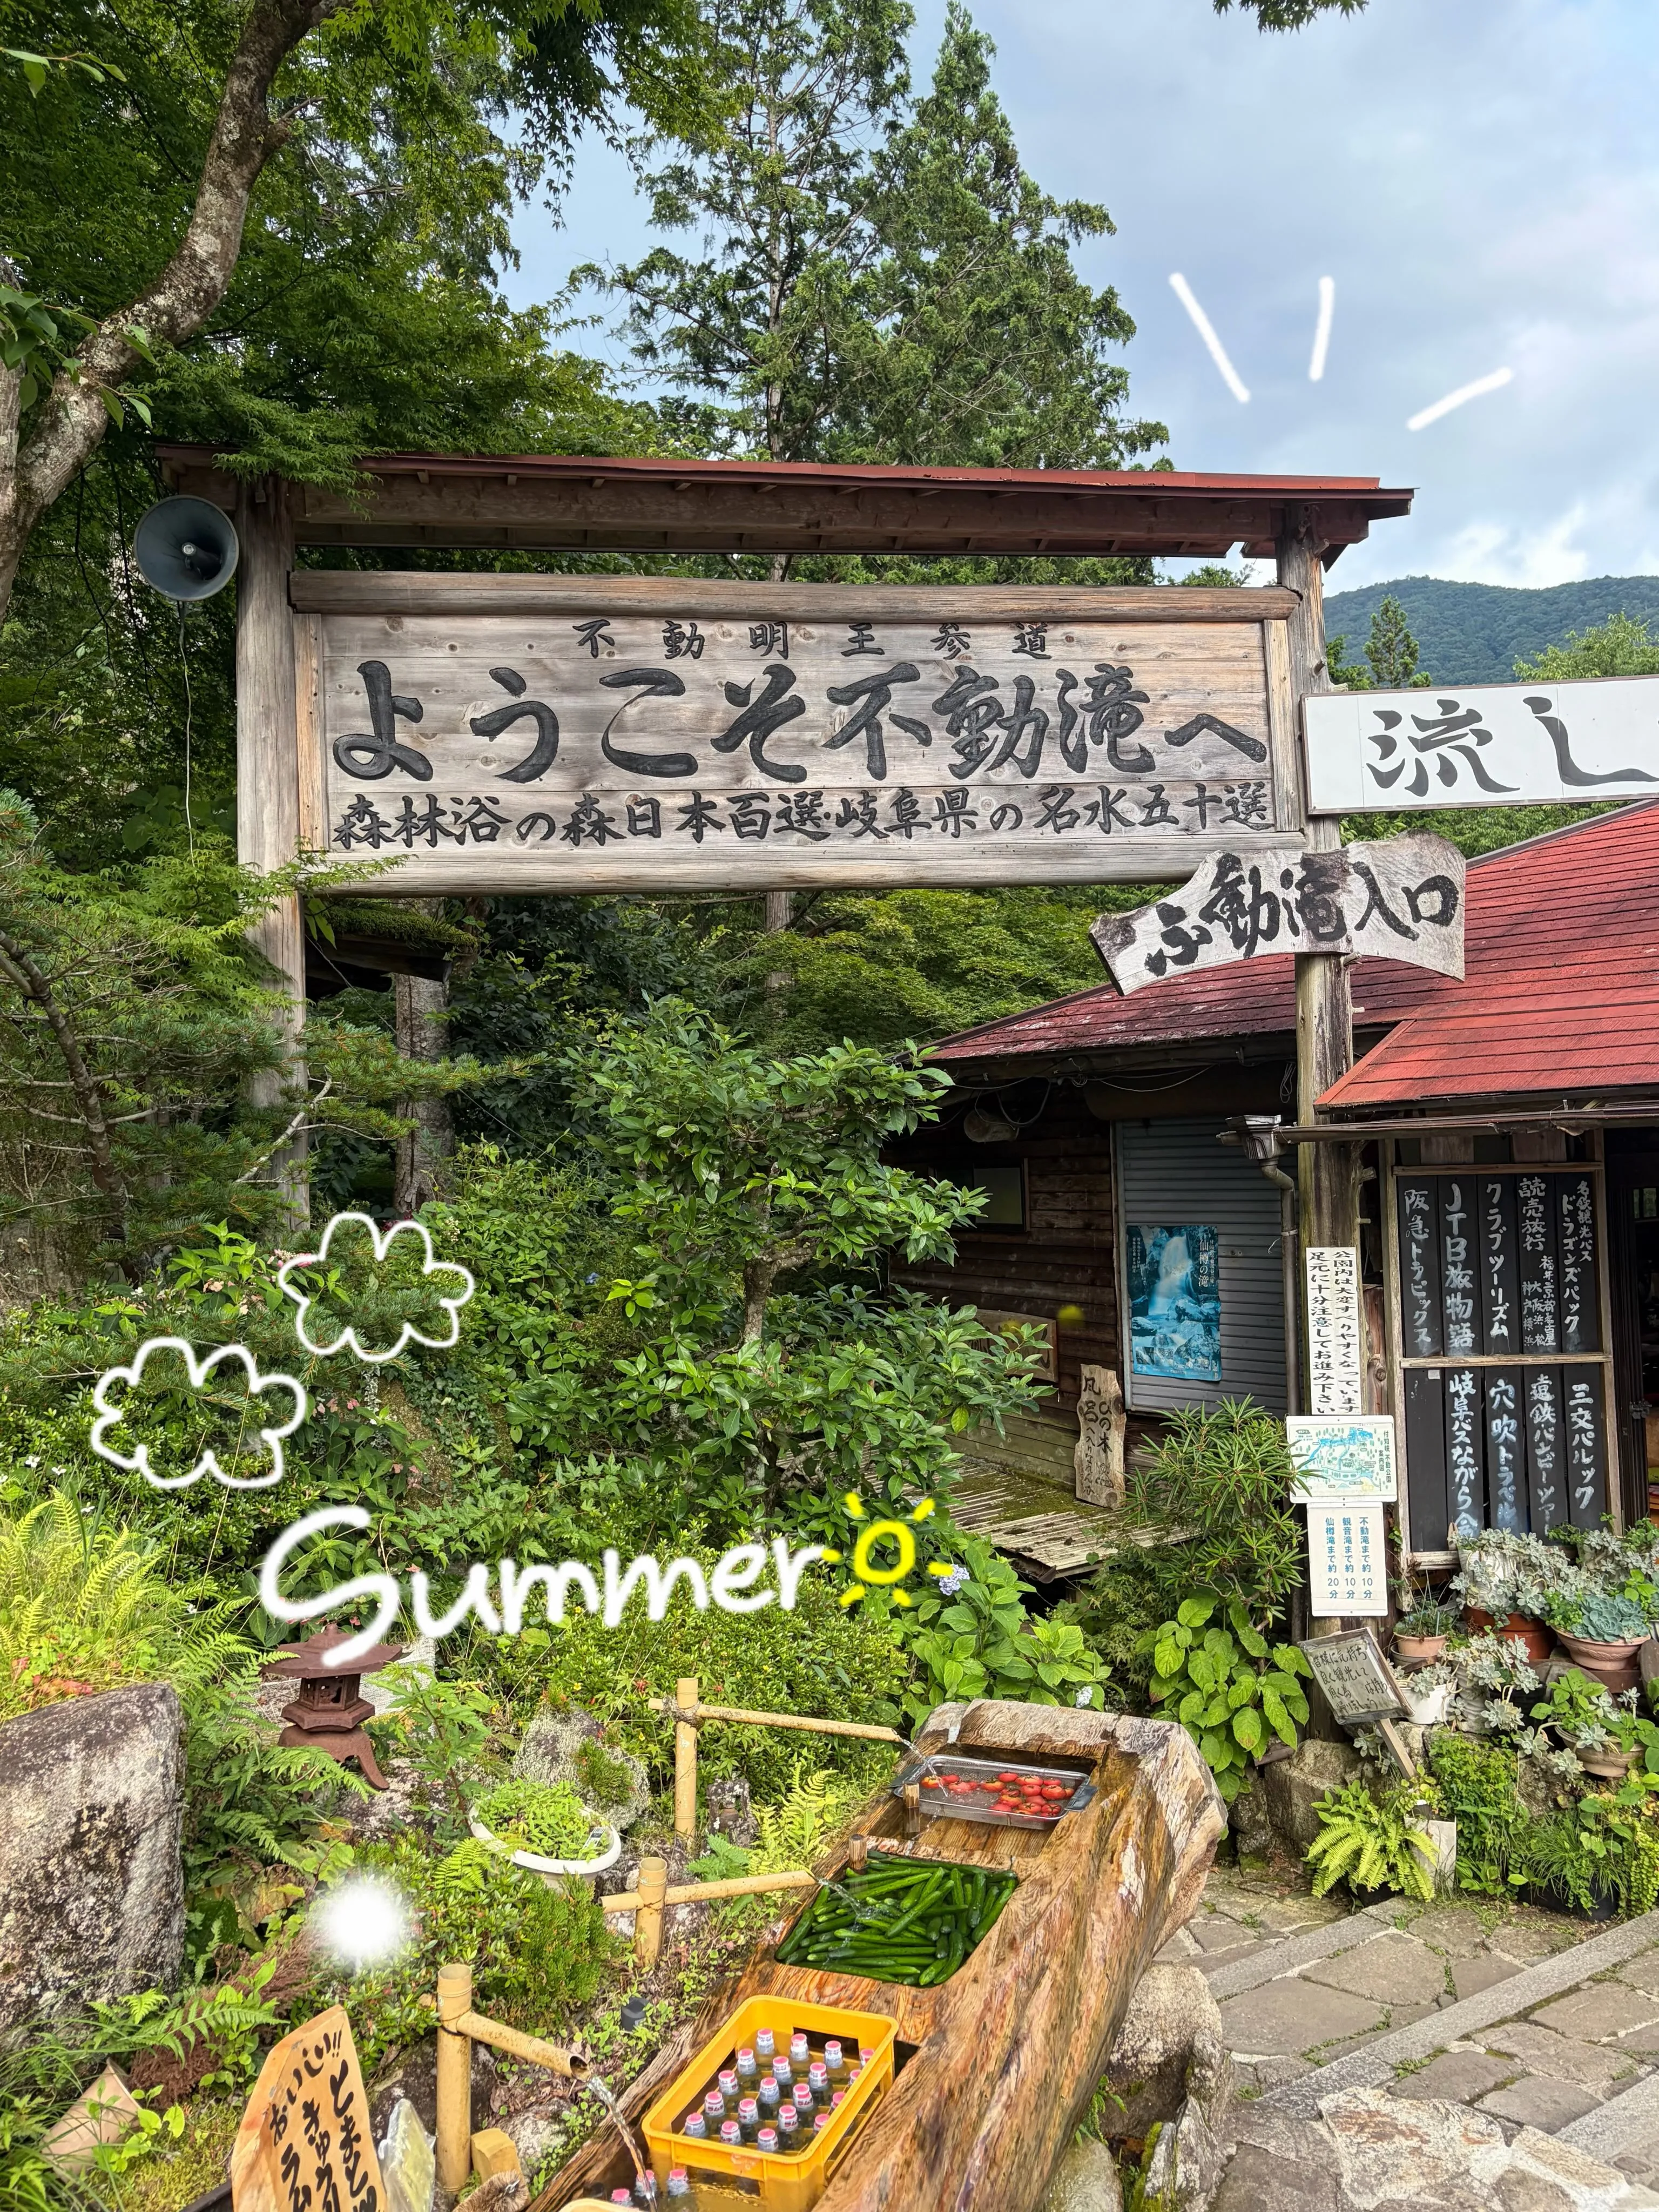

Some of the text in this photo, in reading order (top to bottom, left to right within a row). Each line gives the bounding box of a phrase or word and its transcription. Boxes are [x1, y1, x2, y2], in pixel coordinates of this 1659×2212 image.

[572, 619, 1051, 660] 不動明王参道
[332, 660, 1267, 783] ようこそ不動滝へ
[1144, 852, 1459, 976] 不動滝入口
[1404, 1189, 1431, 1343] 阪急トラピックス
[1445, 1183, 1475, 1347] JTB旅物語
[1486, 1183, 1509, 1337] クラブツーリズム
[1518, 1176, 1547, 1251] 読売旅行
[1562, 1194, 1581, 1333] ドラゴンズパック
[1309, 1252, 1335, 1413] 足元に十分注意してお進み下さい
[1332, 1250, 1359, 1413] 公園内は大変すべりやすくなっています
[1569, 1383, 1595, 1509] 三交パルック
